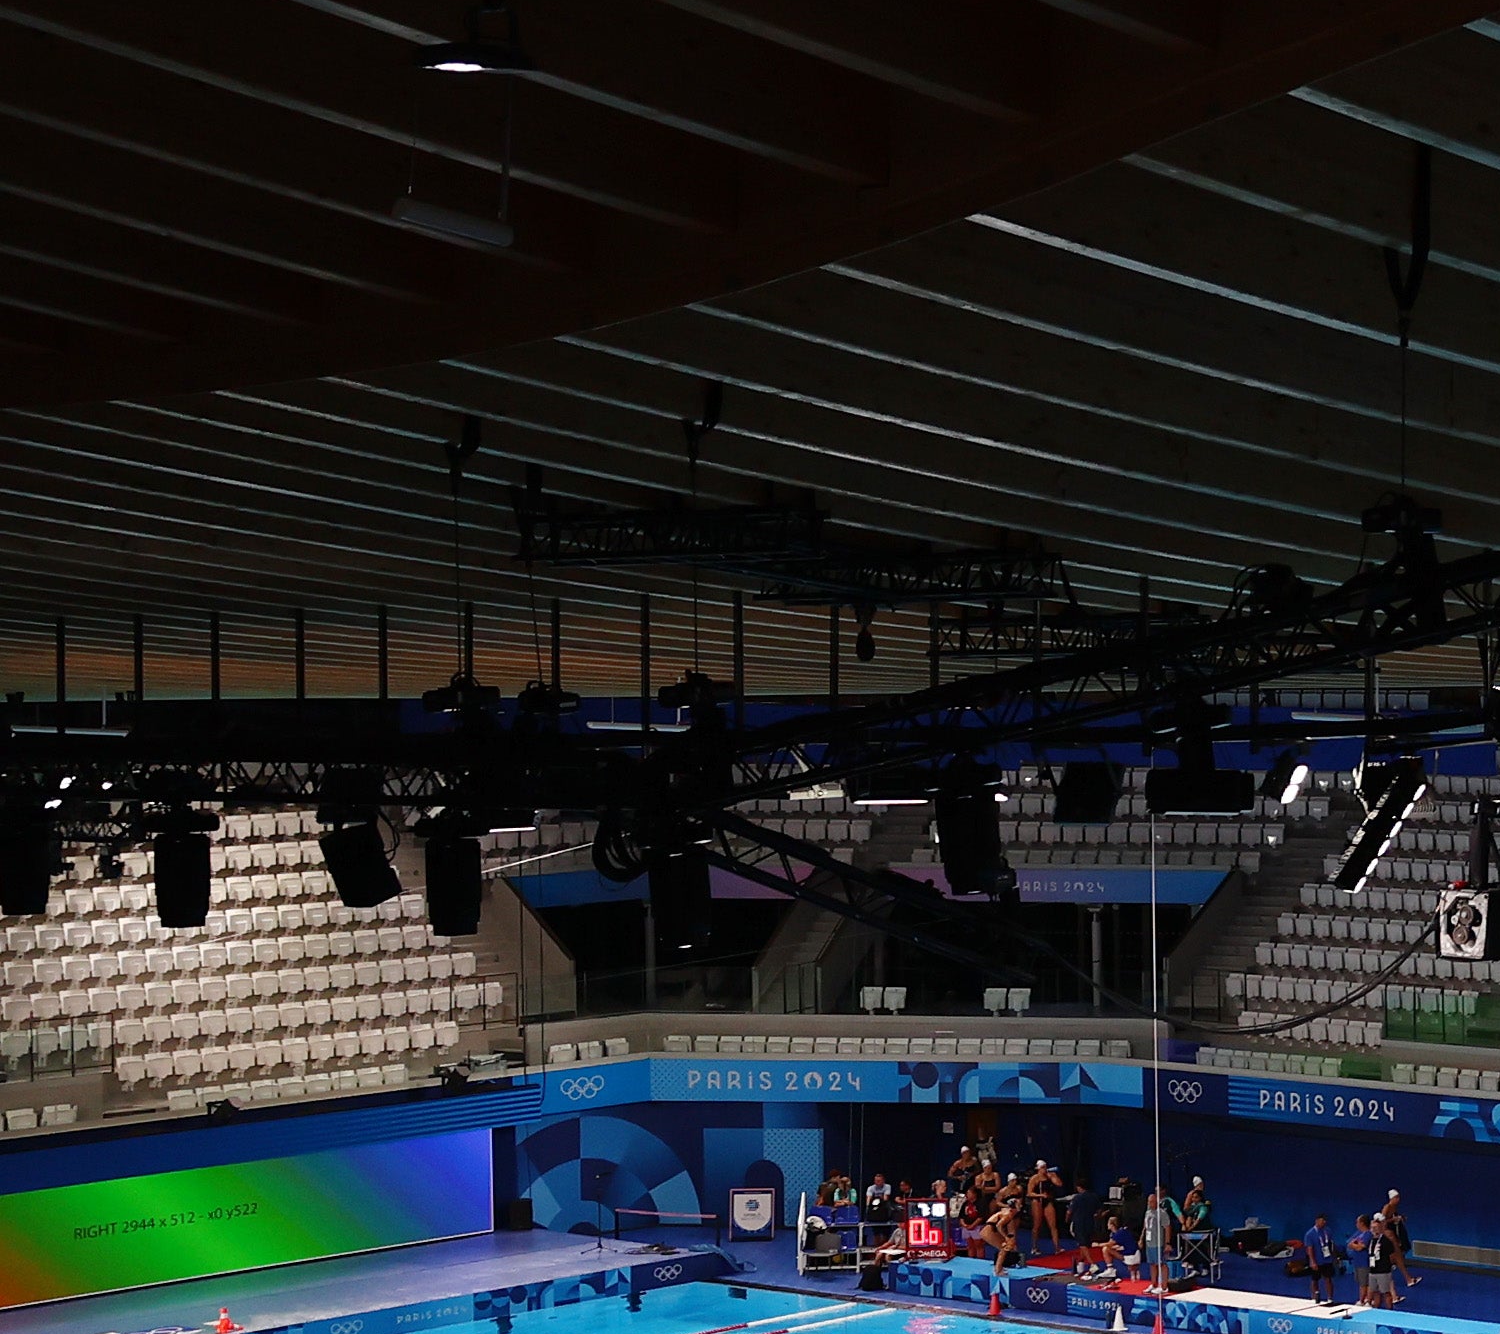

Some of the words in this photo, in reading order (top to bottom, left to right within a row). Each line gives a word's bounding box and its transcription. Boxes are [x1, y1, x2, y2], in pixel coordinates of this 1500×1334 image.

[1018, 881, 1058, 893] ARIS
[785, 1071, 861, 1091] 2024
[1334, 1096, 1394, 1121] 2024
[73, 1223, 118, 1240] RIGHT
[121, 1218, 156, 1234] 2944
[170, 1211, 196, 1225] 512
[226, 1202, 258, 1221] y522
[918, 1249, 947, 1258] OMEGA
